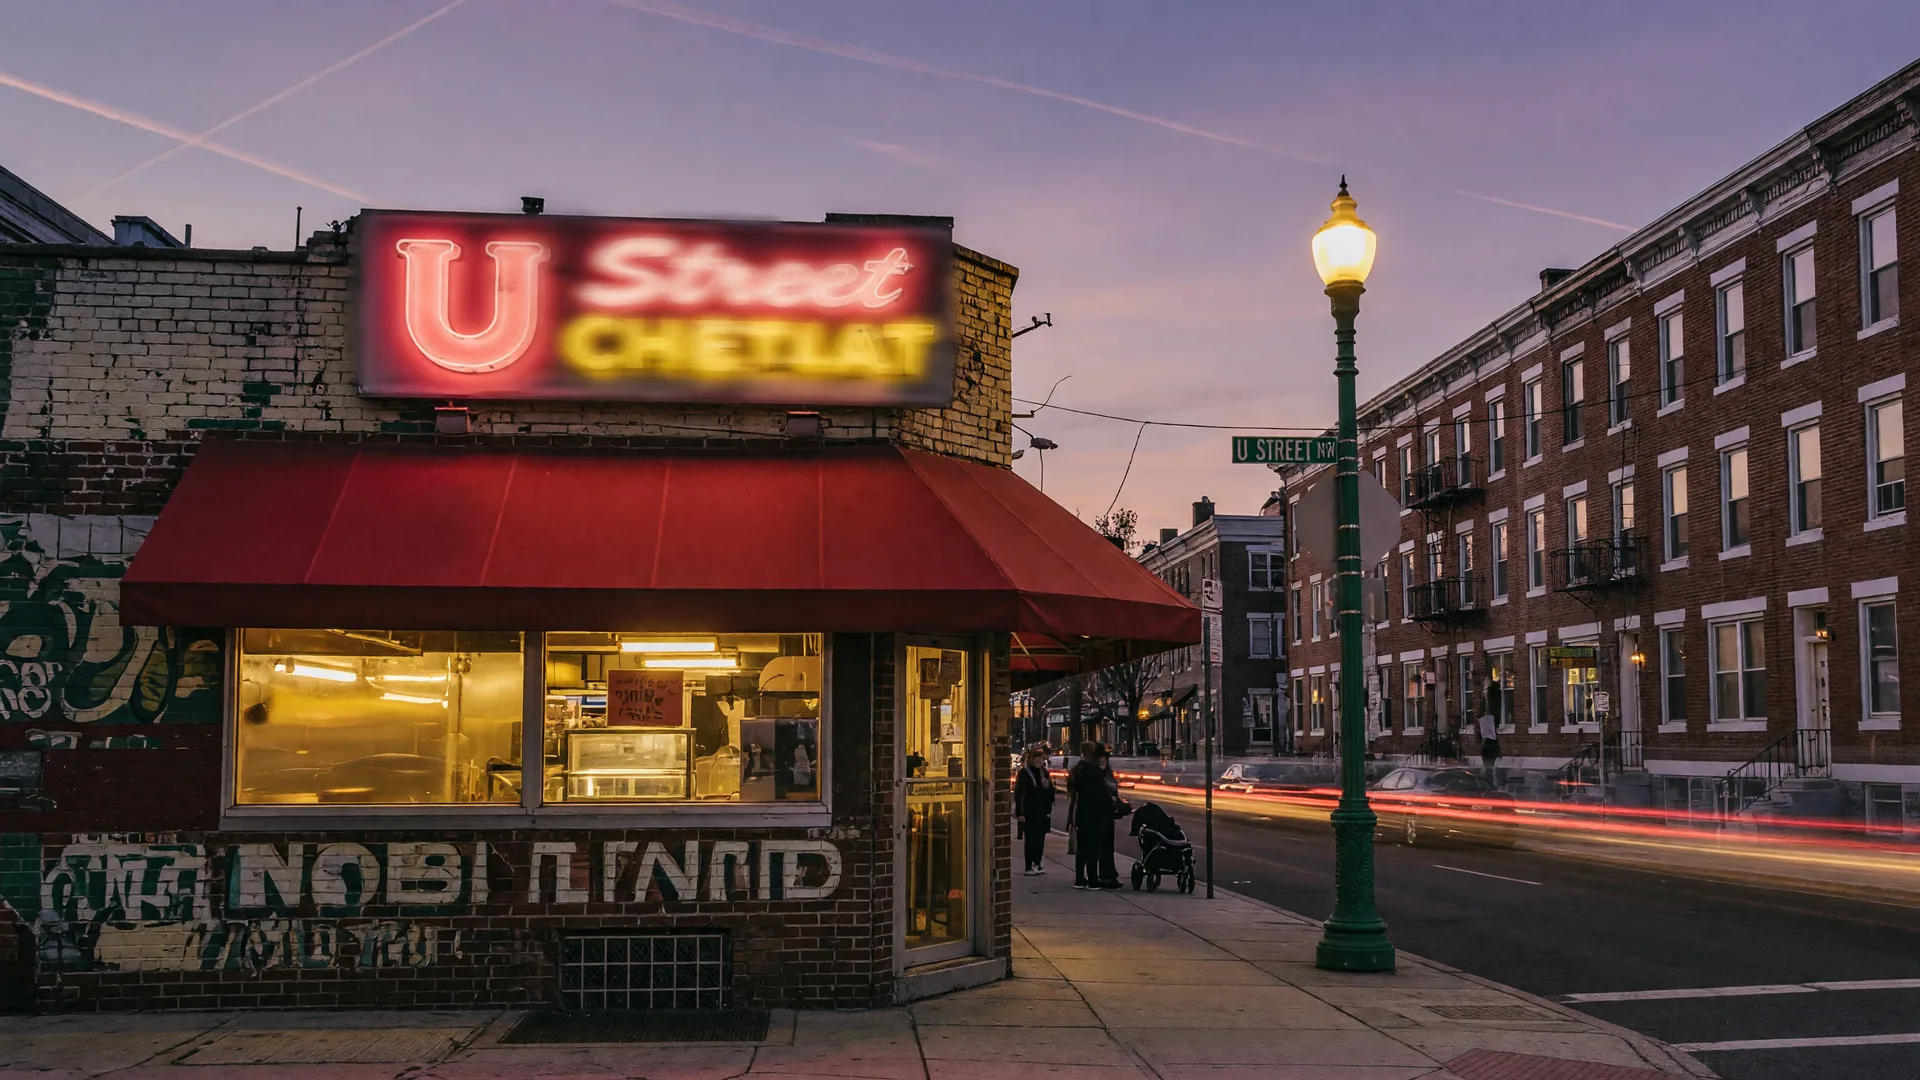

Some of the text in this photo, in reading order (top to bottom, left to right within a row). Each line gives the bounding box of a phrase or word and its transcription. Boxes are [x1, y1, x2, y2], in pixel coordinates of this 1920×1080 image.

[395, 237, 914, 374] U Street
[1237, 438, 1335, 461] U STREET NW
